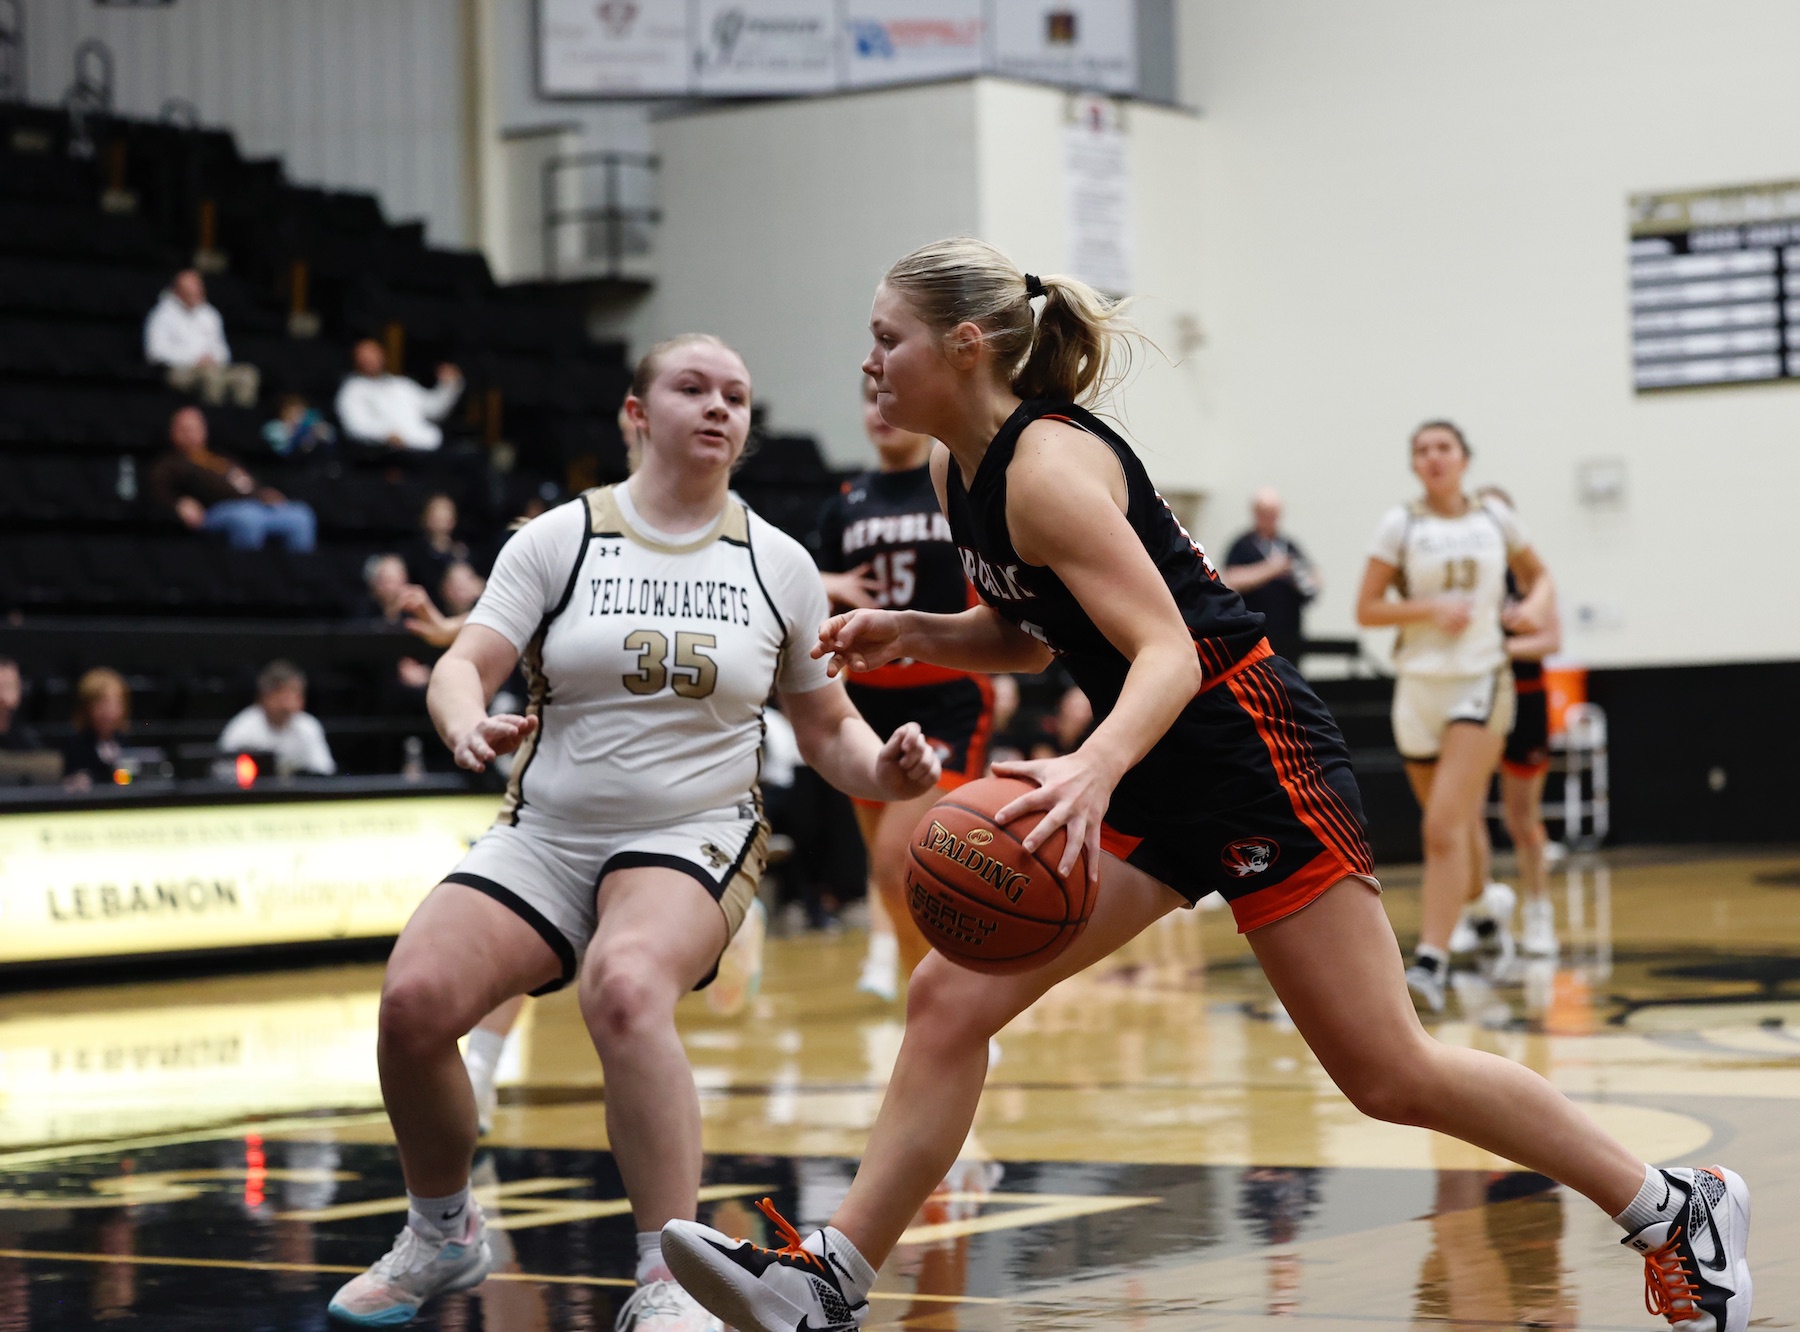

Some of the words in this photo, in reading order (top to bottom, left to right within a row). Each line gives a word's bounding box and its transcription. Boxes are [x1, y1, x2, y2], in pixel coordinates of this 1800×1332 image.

[589, 577, 750, 627] YELLOWJACKETS
[874, 549, 918, 607] 15
[621, 629, 718, 700] 35
[919, 820, 1031, 904] SPALDING
[46, 878, 238, 922] LEBANON
[907, 868, 999, 937] LEGACY
